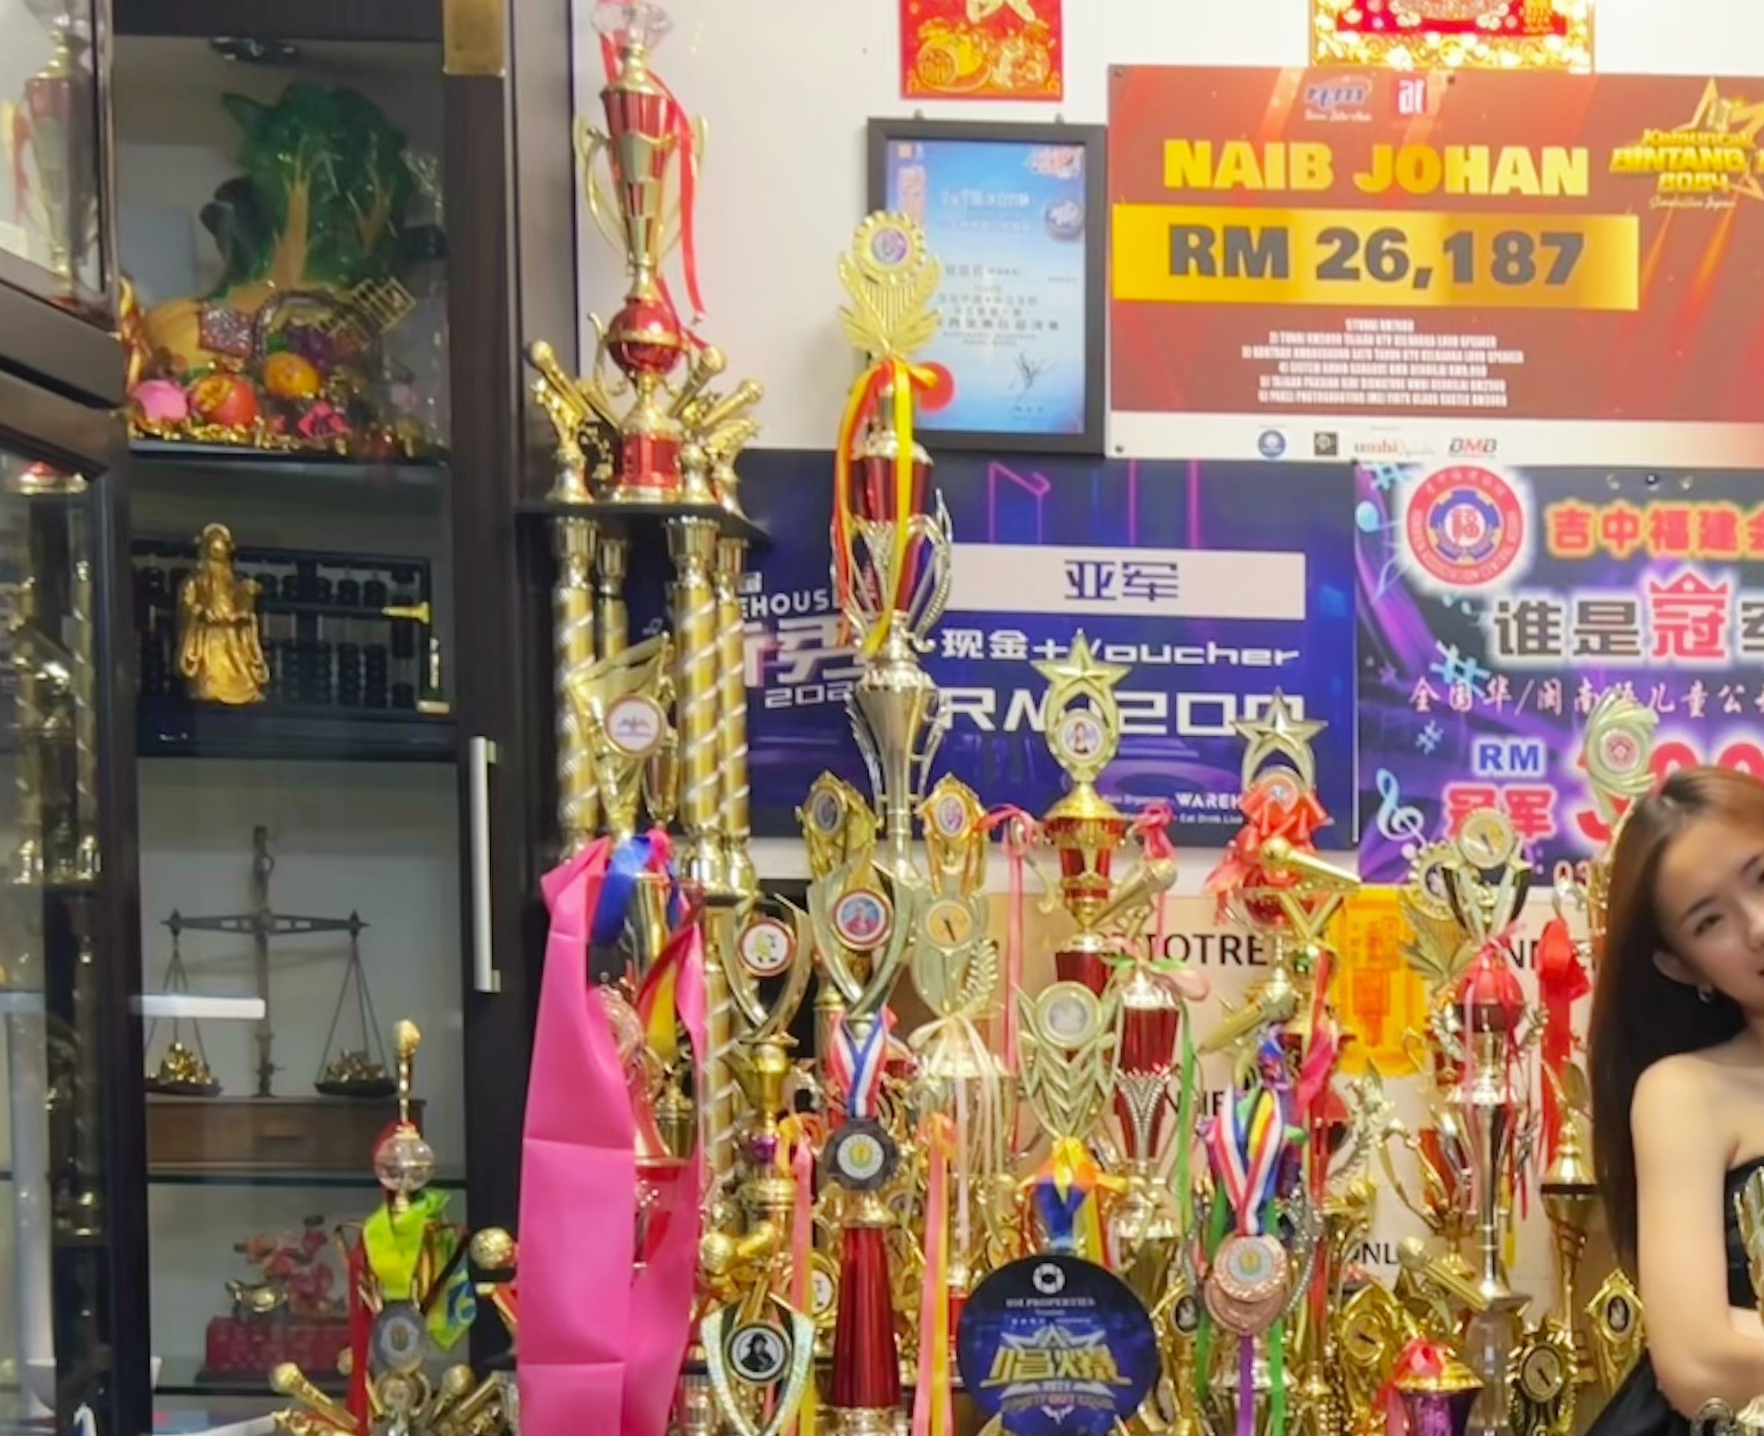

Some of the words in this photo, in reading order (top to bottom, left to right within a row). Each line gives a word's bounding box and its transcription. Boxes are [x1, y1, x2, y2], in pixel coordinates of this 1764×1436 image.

[1163, 139, 1334, 192] NAIB
[1352, 144, 1589, 196] JOHAN
[1168, 224, 1289, 279] RM
[1315, 227, 1585, 290] 26,187
[1064, 558, 1179, 602] 亚军
[1478, 743, 1540, 770] RM
